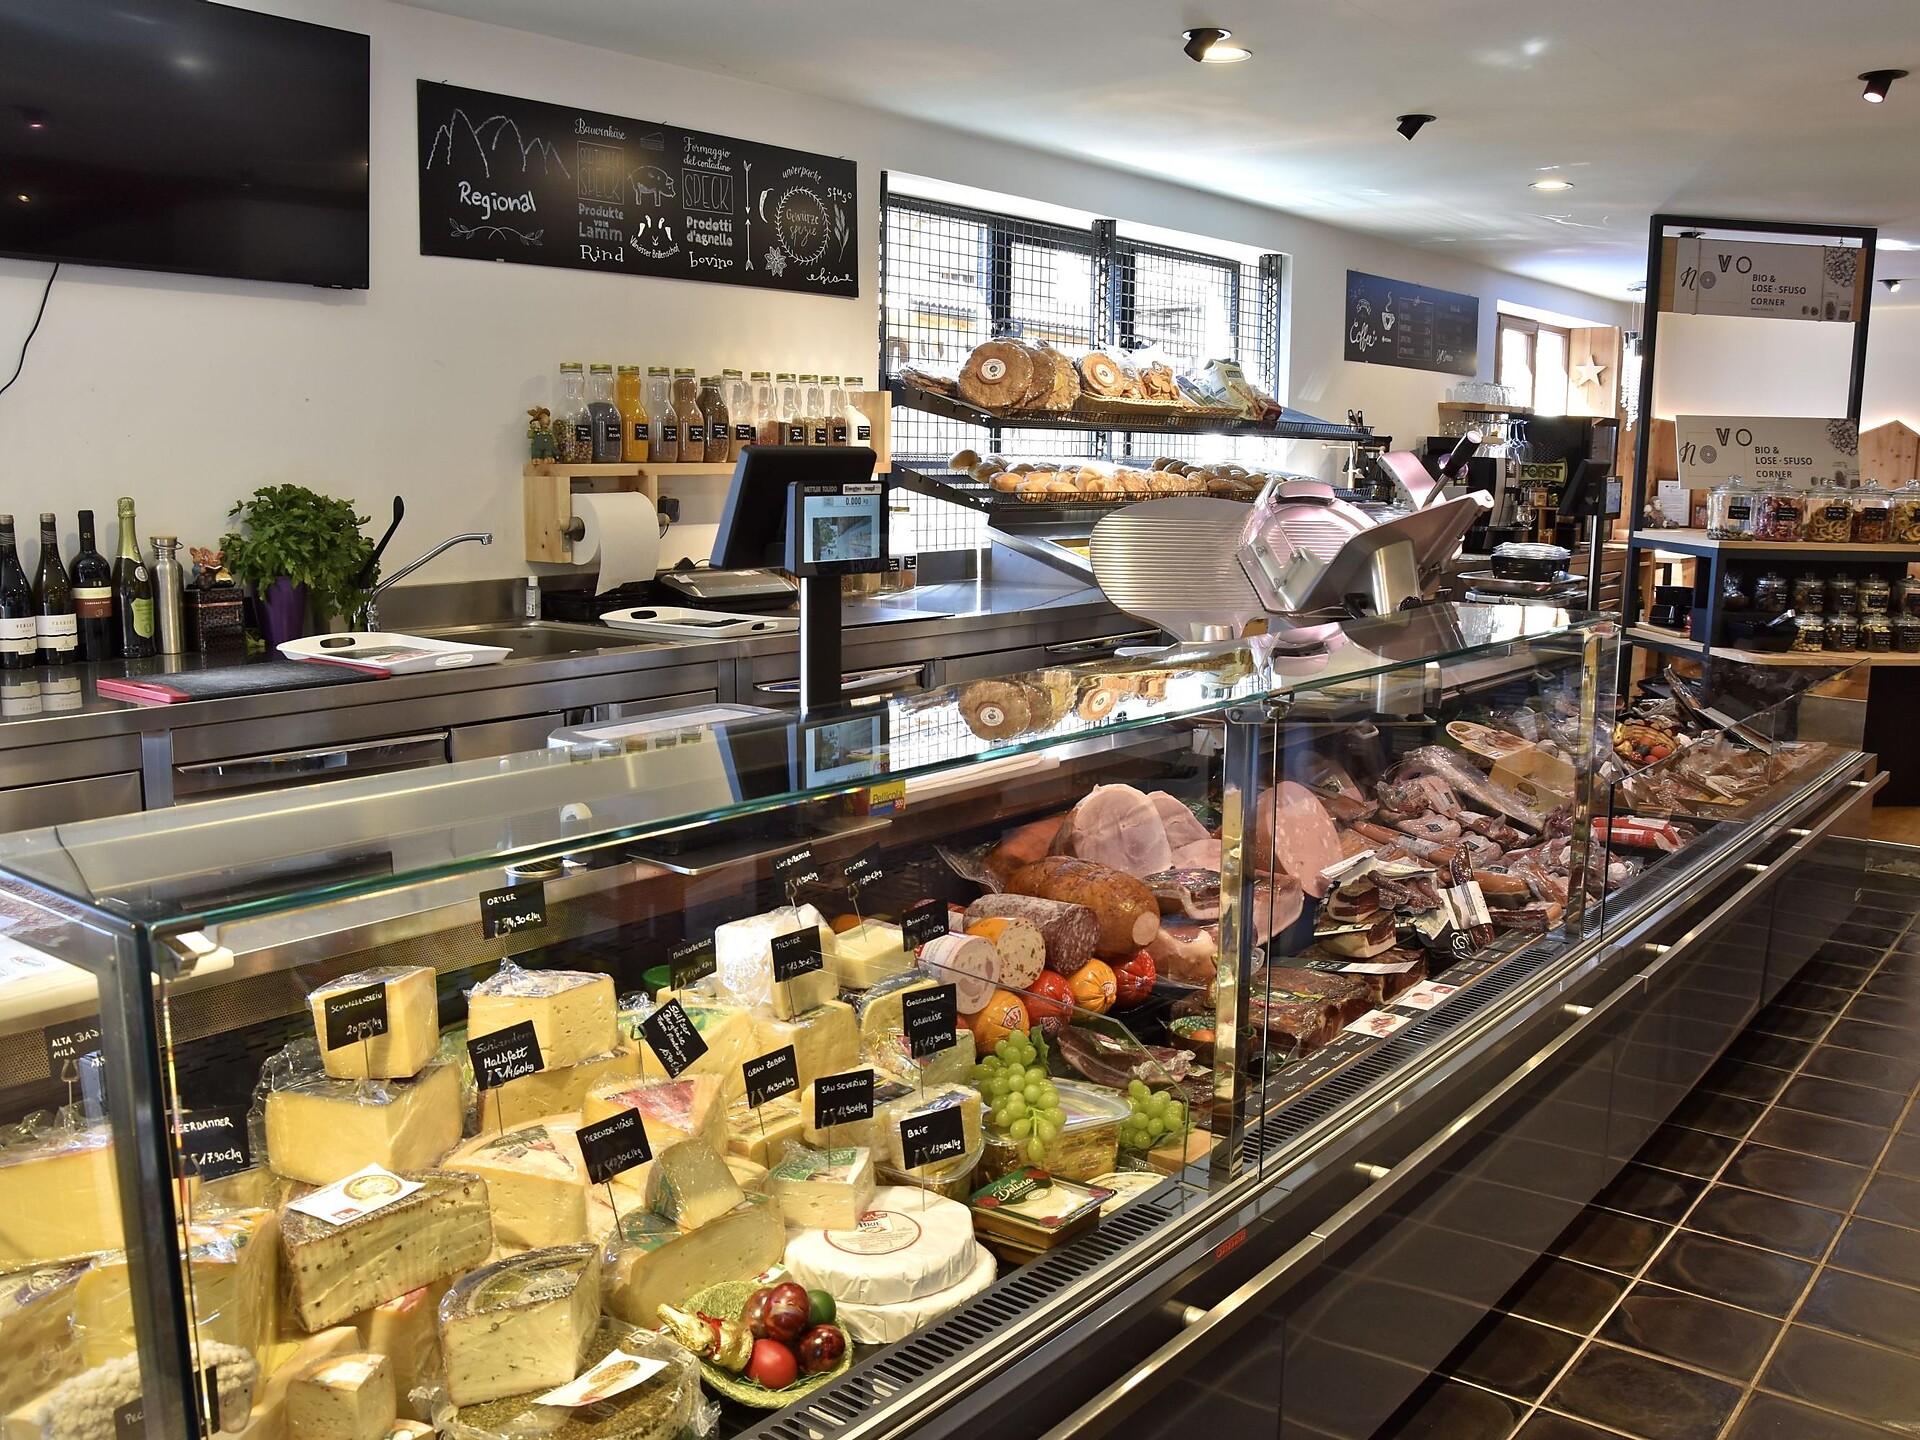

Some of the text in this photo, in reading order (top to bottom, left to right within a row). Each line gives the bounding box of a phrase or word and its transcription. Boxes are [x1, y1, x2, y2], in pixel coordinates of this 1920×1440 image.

[683, 136, 731, 160] Formaggio
[683, 155, 731, 172] del contadino
[684, 173, 730, 211] SPECK
[827, 187, 853, 204] sfuso
[458, 181, 537, 220] Regional
[578, 202, 624, 220] Produkte
[786, 207, 819, 225] Gewürze
[594, 219, 609, 228] vom
[686, 215, 732, 233] Prodotti
[579, 221, 623, 242] Lamm
[686, 230, 733, 247] d'agnello
[580, 244, 625, 263] Rind
[689, 251, 734, 270] bovino
[1752, 273, 1776, 283] BIO &
[1752, 284, 1807, 295] LOSE SFUSO
[1750, 297, 1786, 307] CORNER
[1754, 446, 1780, 455] BIO &
[1755, 457, 1813, 466] LOSE SFUSO
[1521, 464, 1563, 478] FORST
[1756, 470, 1793, 479] CORNER
[804, 485, 821, 493] METTLER
[822, 485, 837, 493] TOLEDO
[845, 496, 862, 506] 0.000
[872, 789, 903, 804] Pellicola
[487, 893, 517, 906] ORTLER
[776, 936, 801, 951] TILSITER
[662, 1009, 686, 1046] Bergkäse
[51, 1035, 72, 1048] ALTA
[483, 1045, 529, 1069] Halbfett
[747, 1065, 765, 1078] GRAN
[821, 1078, 868, 1094] SAN SEVERINO
[907, 1125, 929, 1139] BRIE
